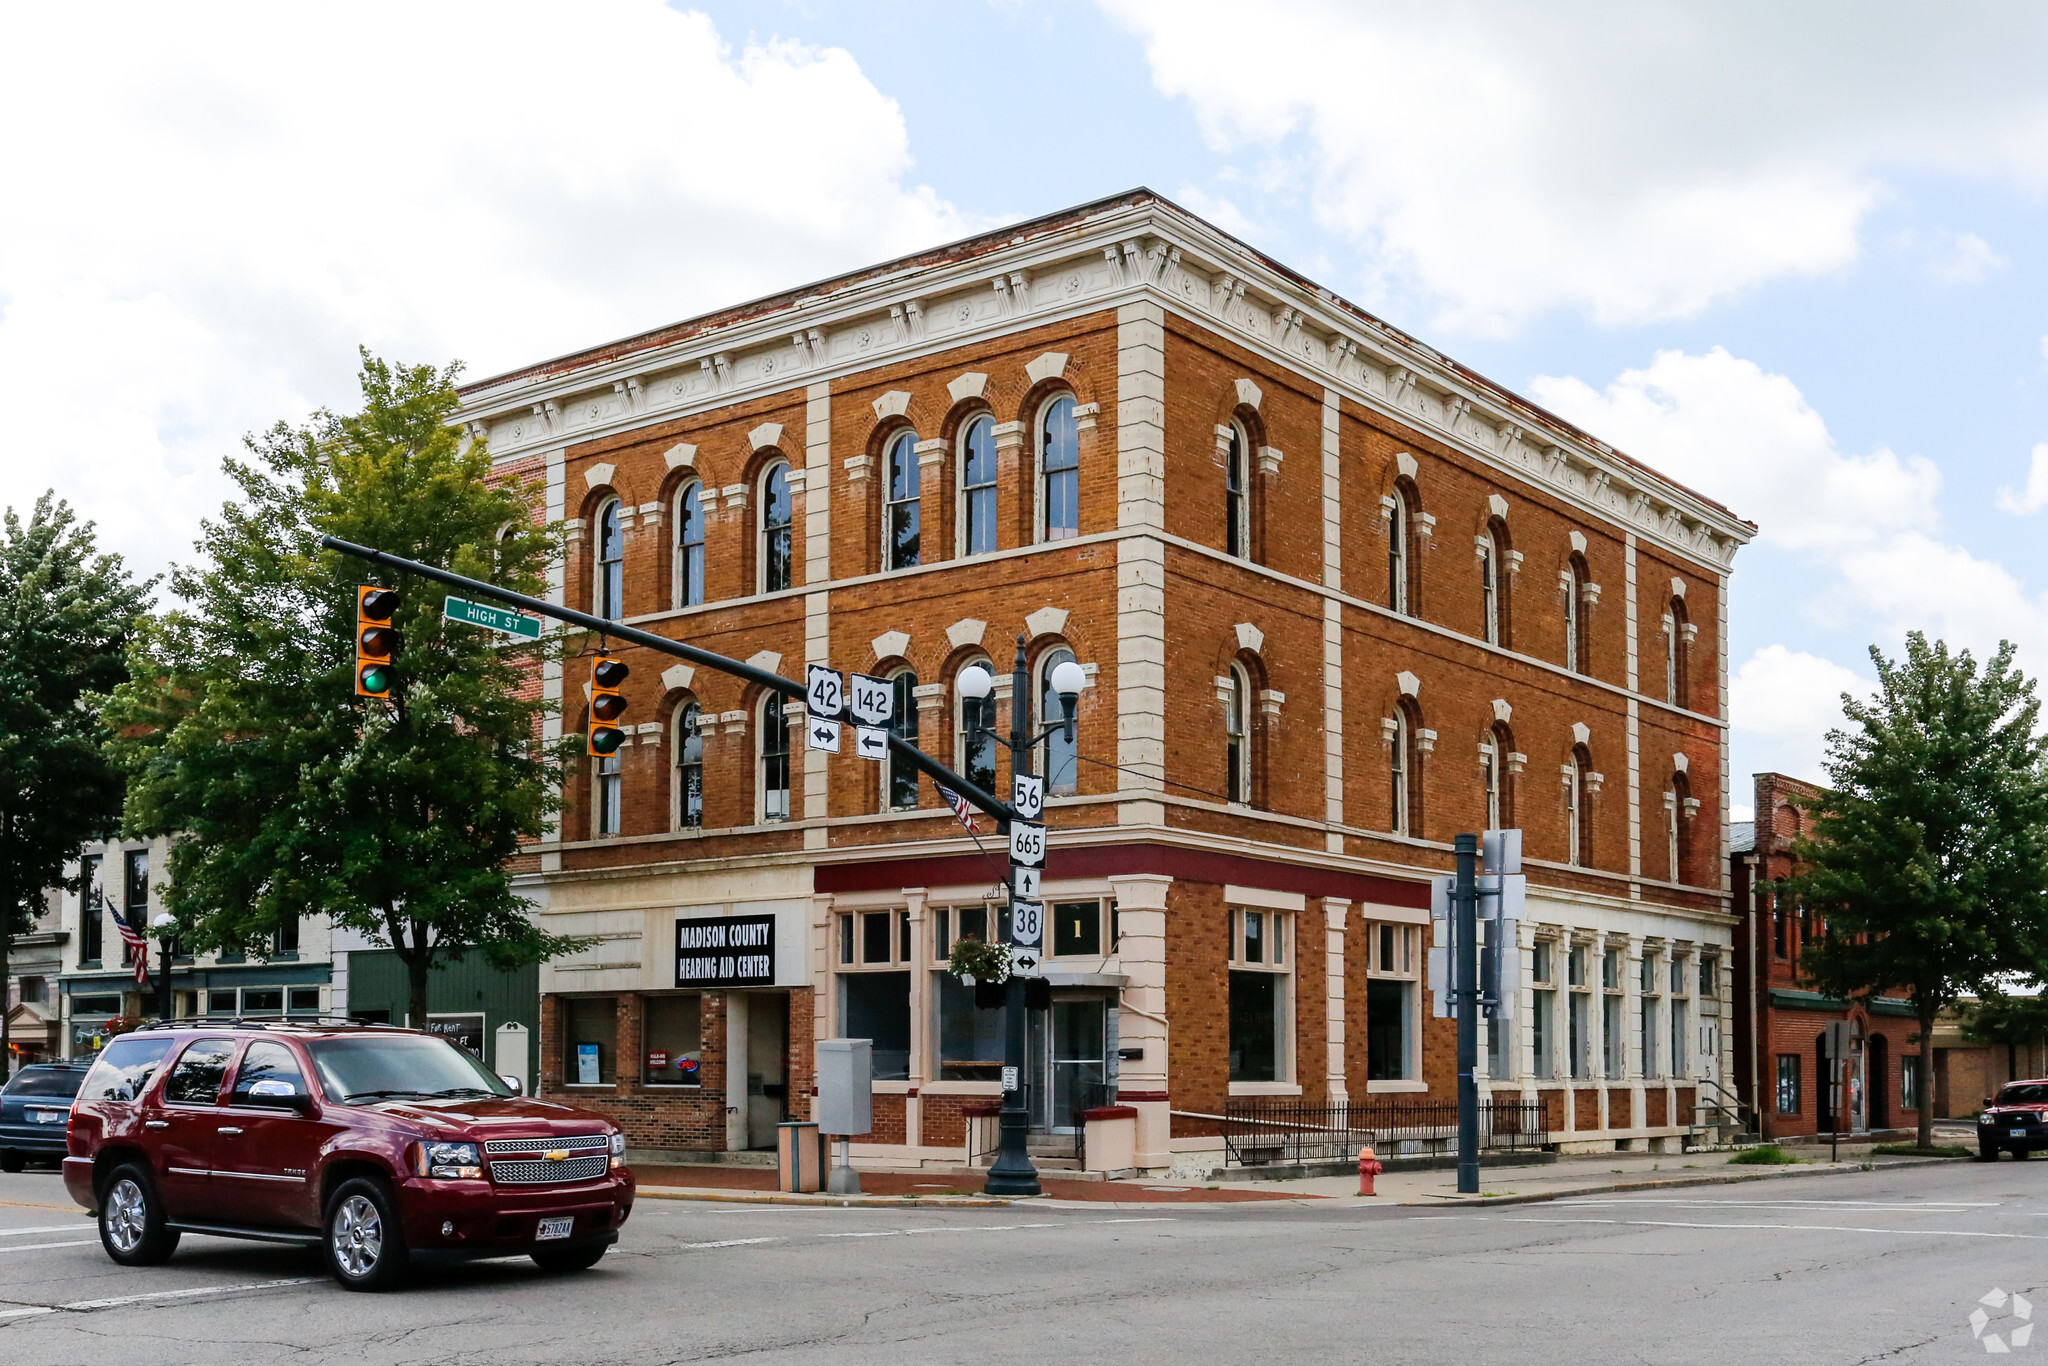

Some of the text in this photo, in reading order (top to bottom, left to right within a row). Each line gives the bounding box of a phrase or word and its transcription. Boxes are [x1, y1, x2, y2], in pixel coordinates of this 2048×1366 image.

[467, 607, 520, 630] HIGH ST
[813, 679, 837, 708] 42
[857, 687, 887, 714] 142
[1016, 782, 1039, 808] 56
[1016, 832, 1040, 855] 665
[1016, 908, 1037, 935] 38
[681, 923, 770, 949] MADISON COUNTY
[680, 955, 770, 979] HEARING AID CENTER
